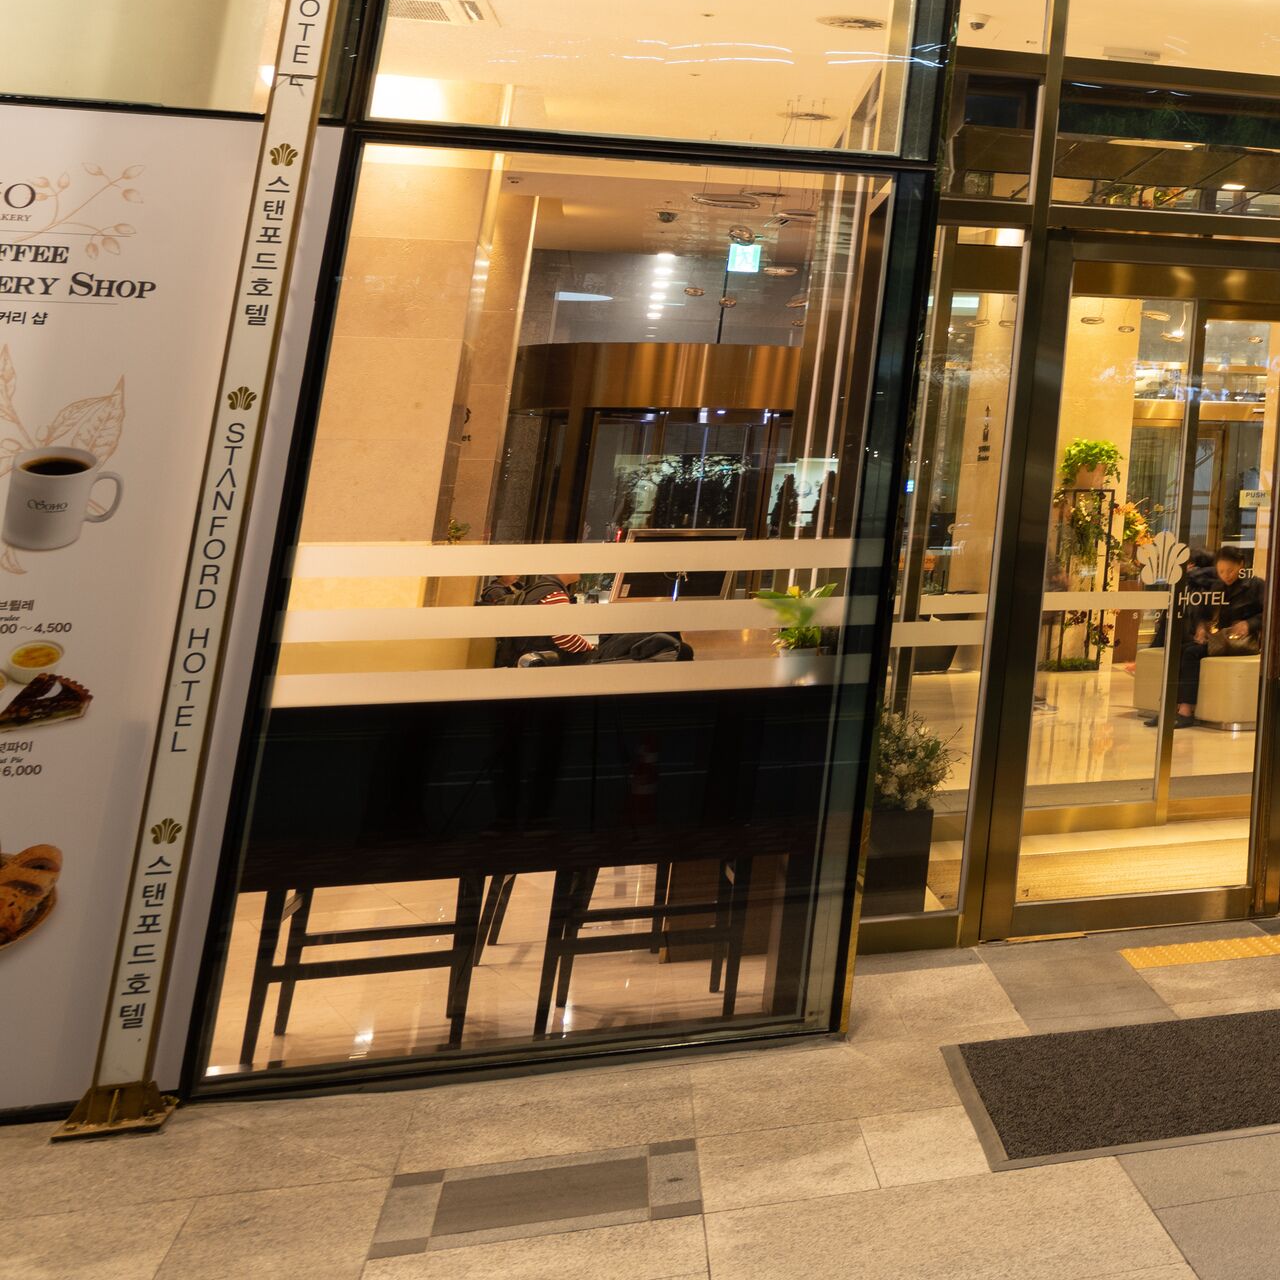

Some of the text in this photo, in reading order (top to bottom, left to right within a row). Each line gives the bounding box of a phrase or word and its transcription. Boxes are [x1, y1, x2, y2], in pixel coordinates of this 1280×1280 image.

[32, 311, 48, 326] 샵
[244, 175, 292, 326] 스탠포드호텔
[170, 422, 247, 752] STANFORD HOTEL
[1178, 591, 1230, 606] HOTEL
[118, 855, 174, 1031] 스탠포드호텔
